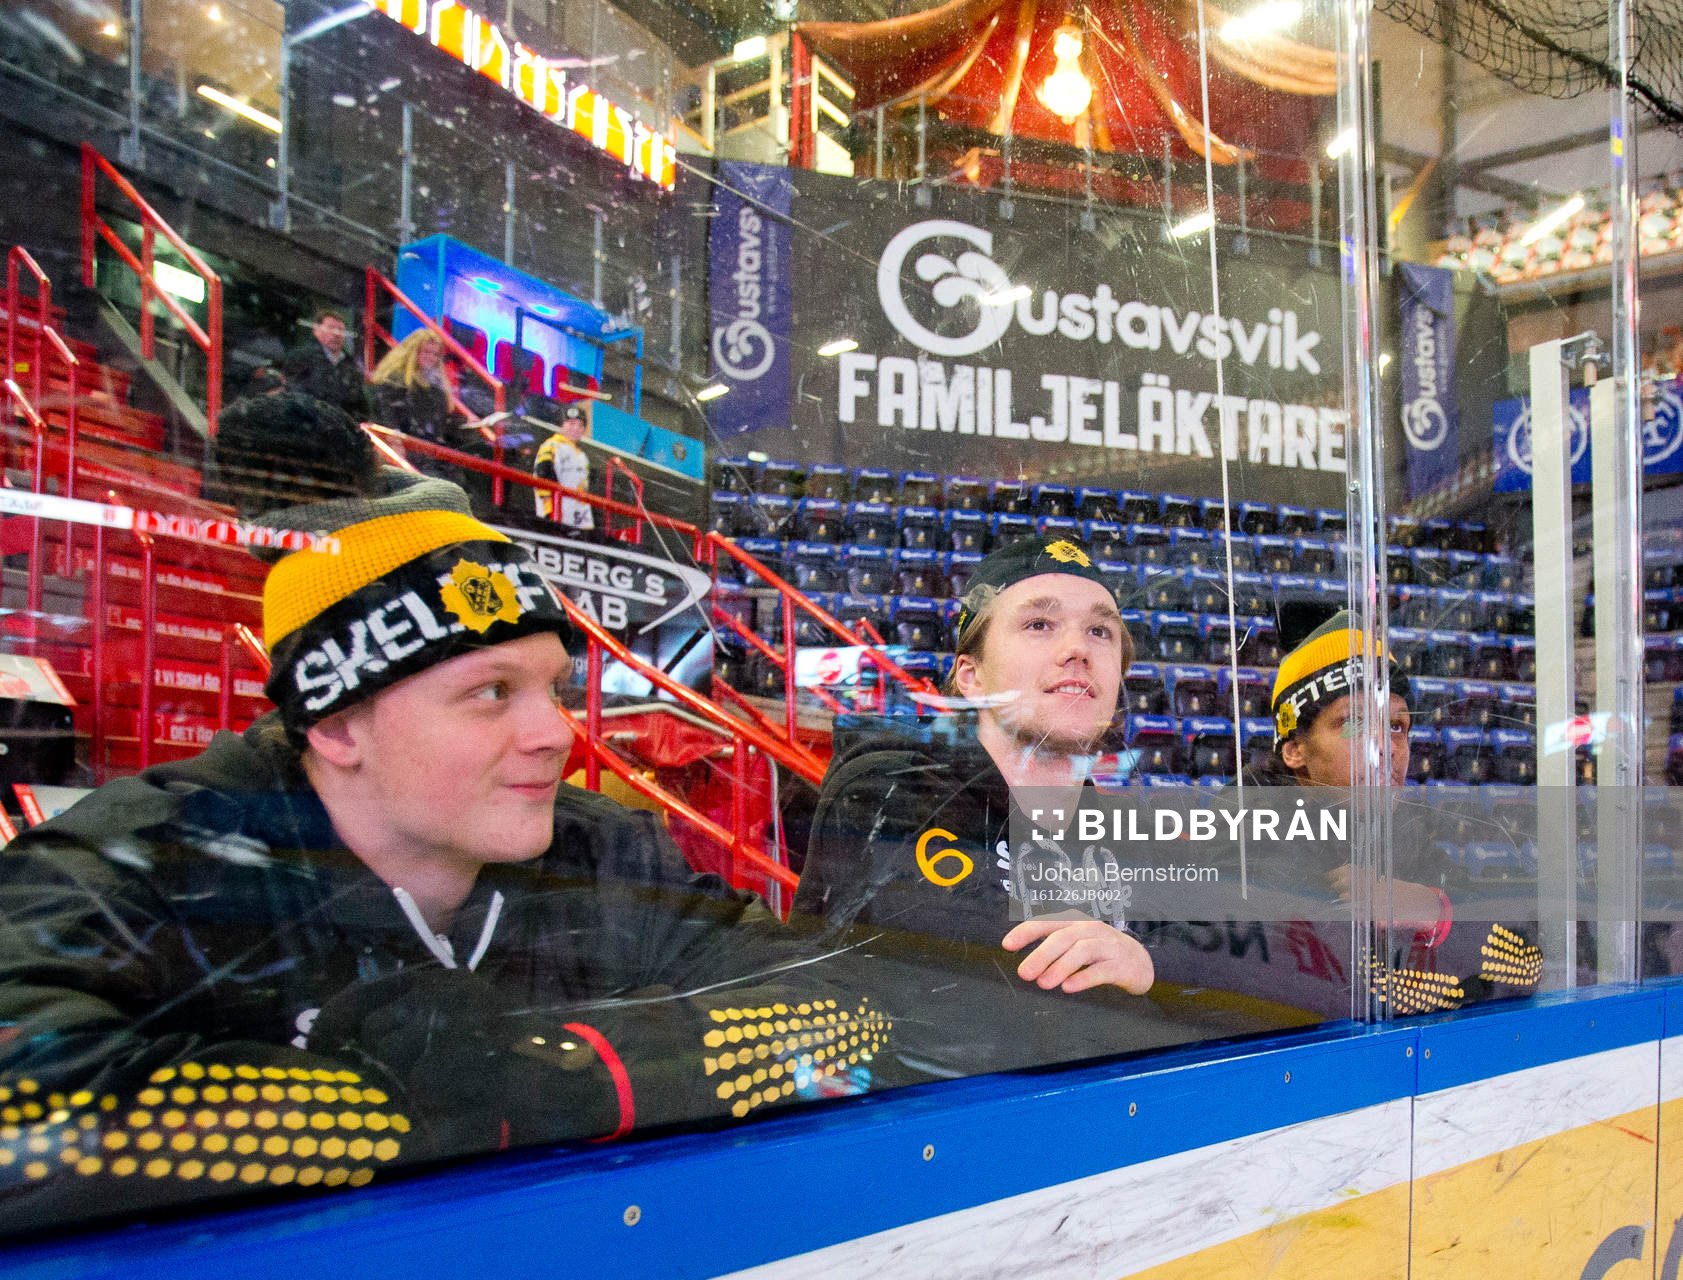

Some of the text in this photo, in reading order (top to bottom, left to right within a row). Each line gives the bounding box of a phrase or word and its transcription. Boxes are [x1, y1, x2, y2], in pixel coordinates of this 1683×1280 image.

[877, 219, 1321, 375] Gustavsvik
[577, 590, 629, 631] AB
[915, 828, 974, 887] 6
